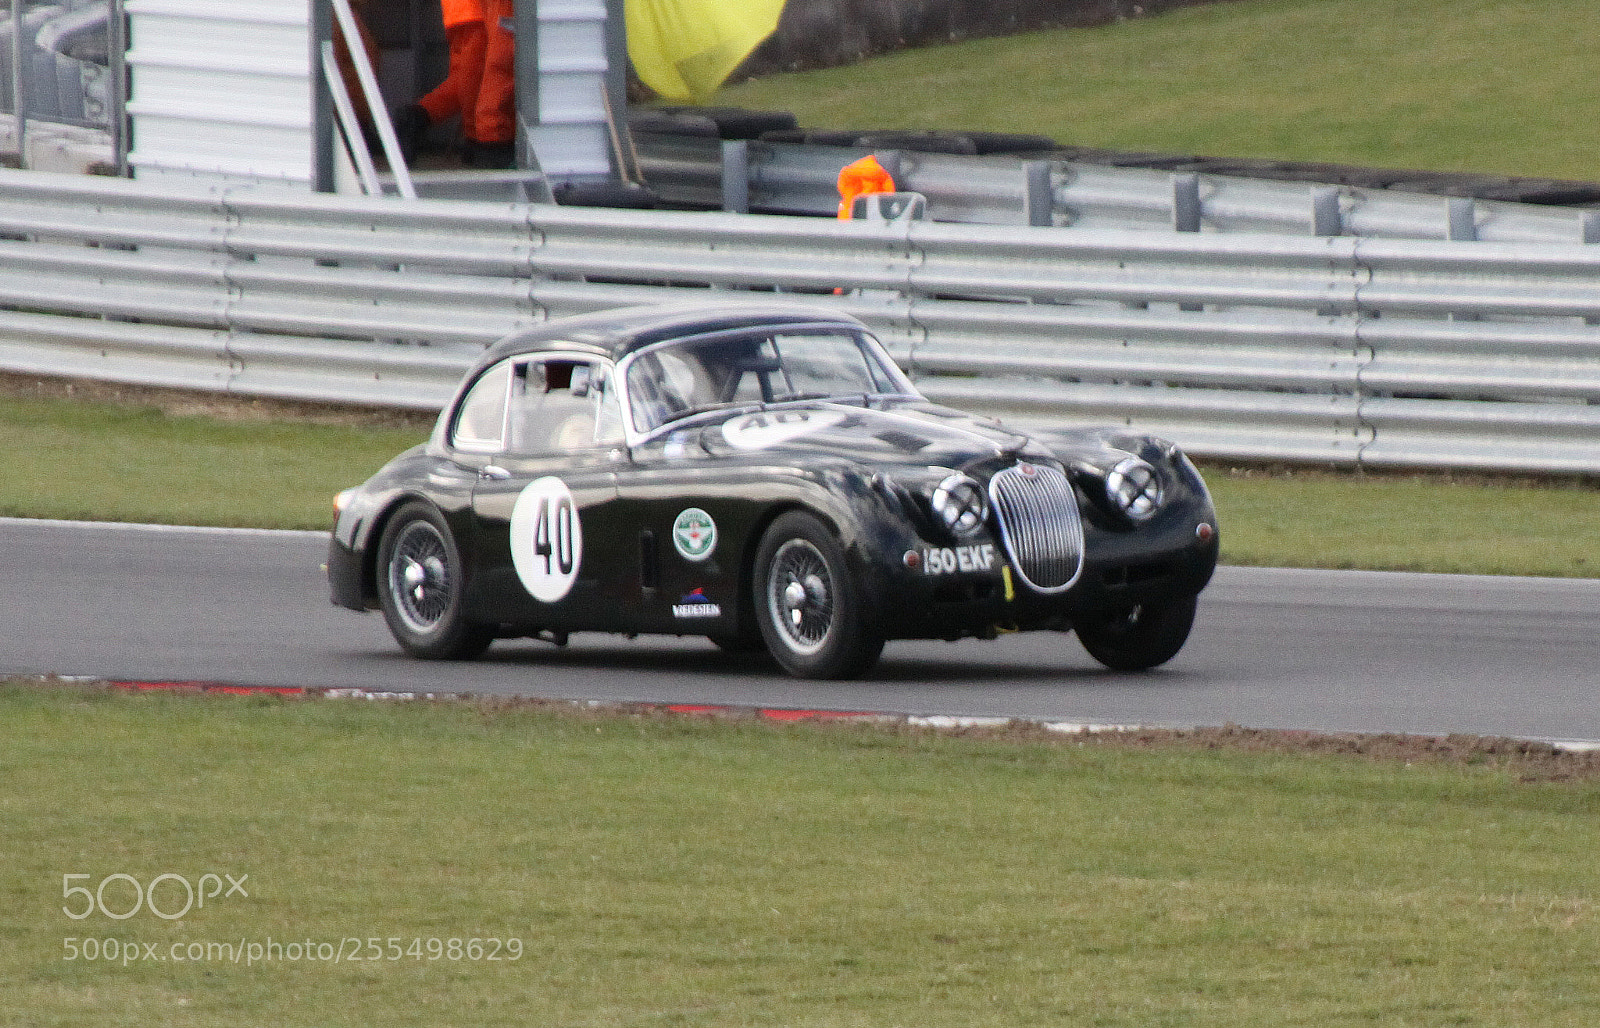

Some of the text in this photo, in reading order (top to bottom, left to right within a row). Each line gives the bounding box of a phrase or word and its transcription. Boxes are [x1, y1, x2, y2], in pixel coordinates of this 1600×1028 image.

[533, 496, 573, 575] 40
[923, 543, 994, 575] 150 EKF
